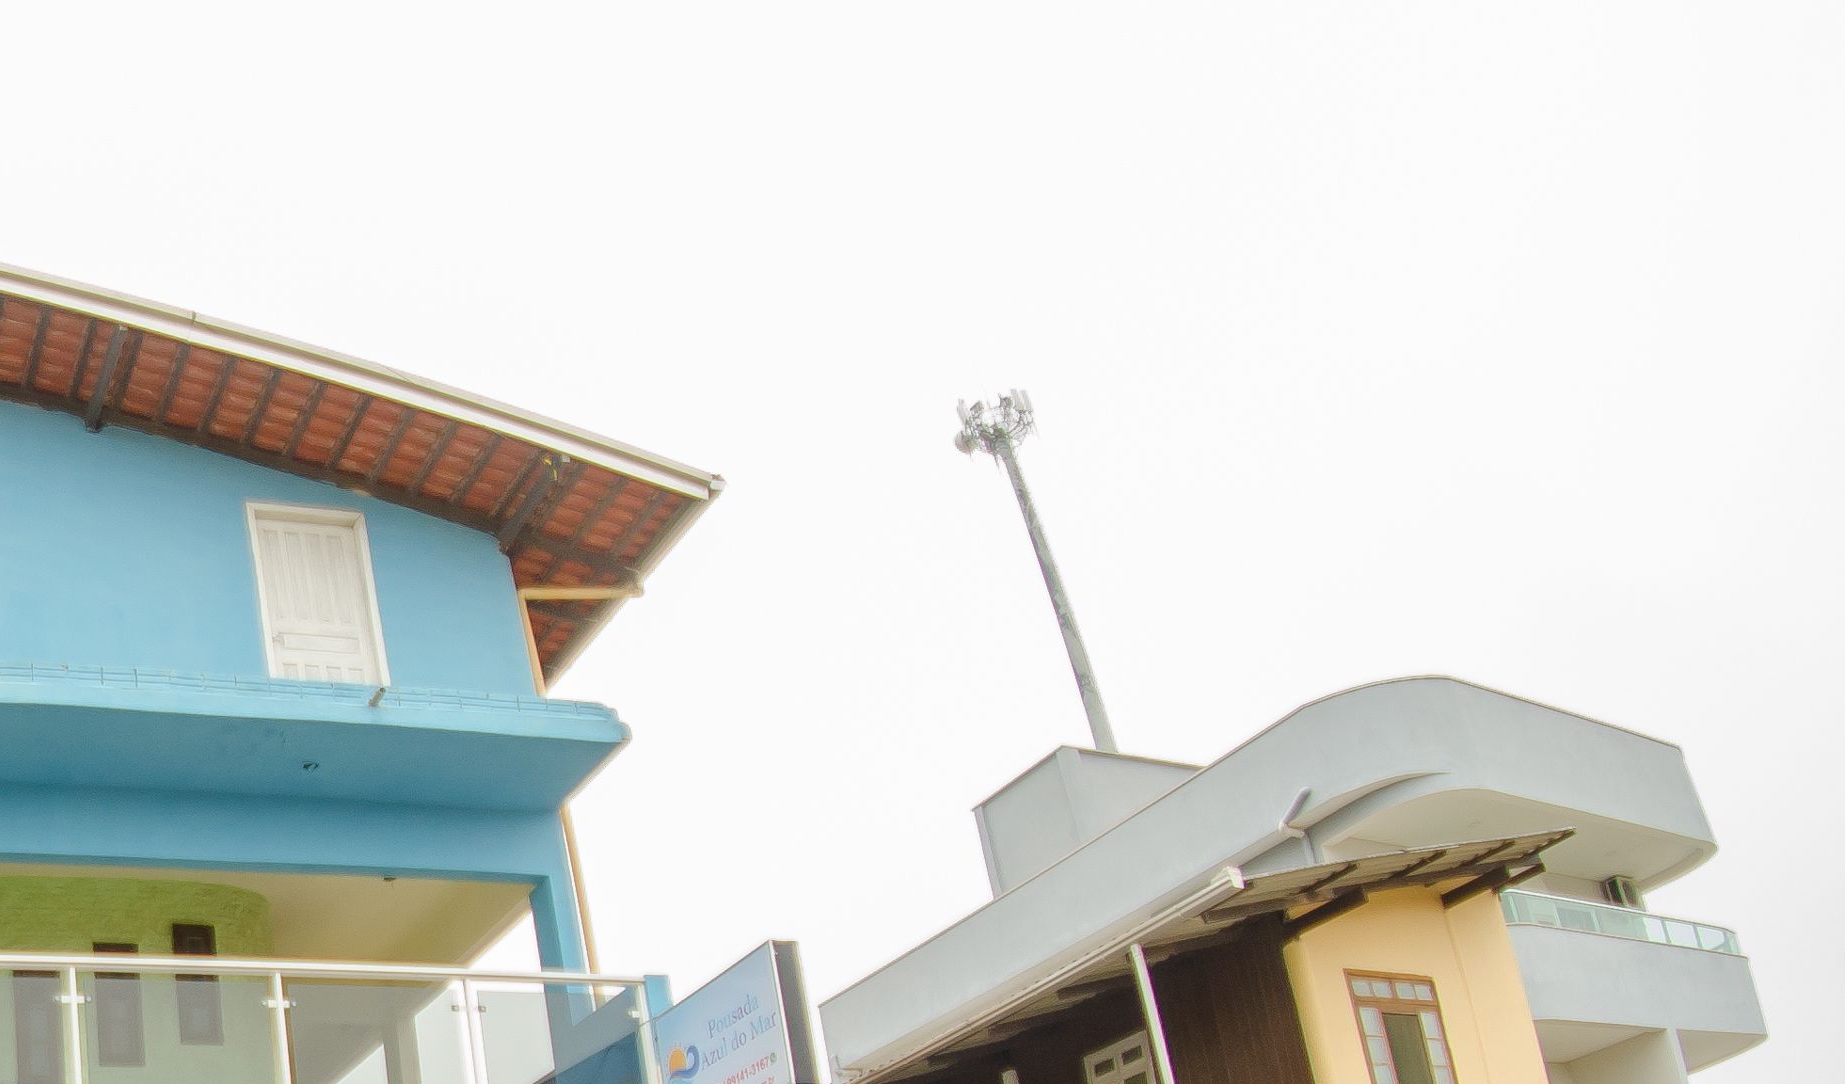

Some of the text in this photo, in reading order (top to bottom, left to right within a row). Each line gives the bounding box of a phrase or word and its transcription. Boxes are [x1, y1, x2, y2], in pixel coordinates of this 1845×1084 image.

[701, 1011, 776, 1071] Azul do Mar
[707, 994, 759, 1039] Pousada
